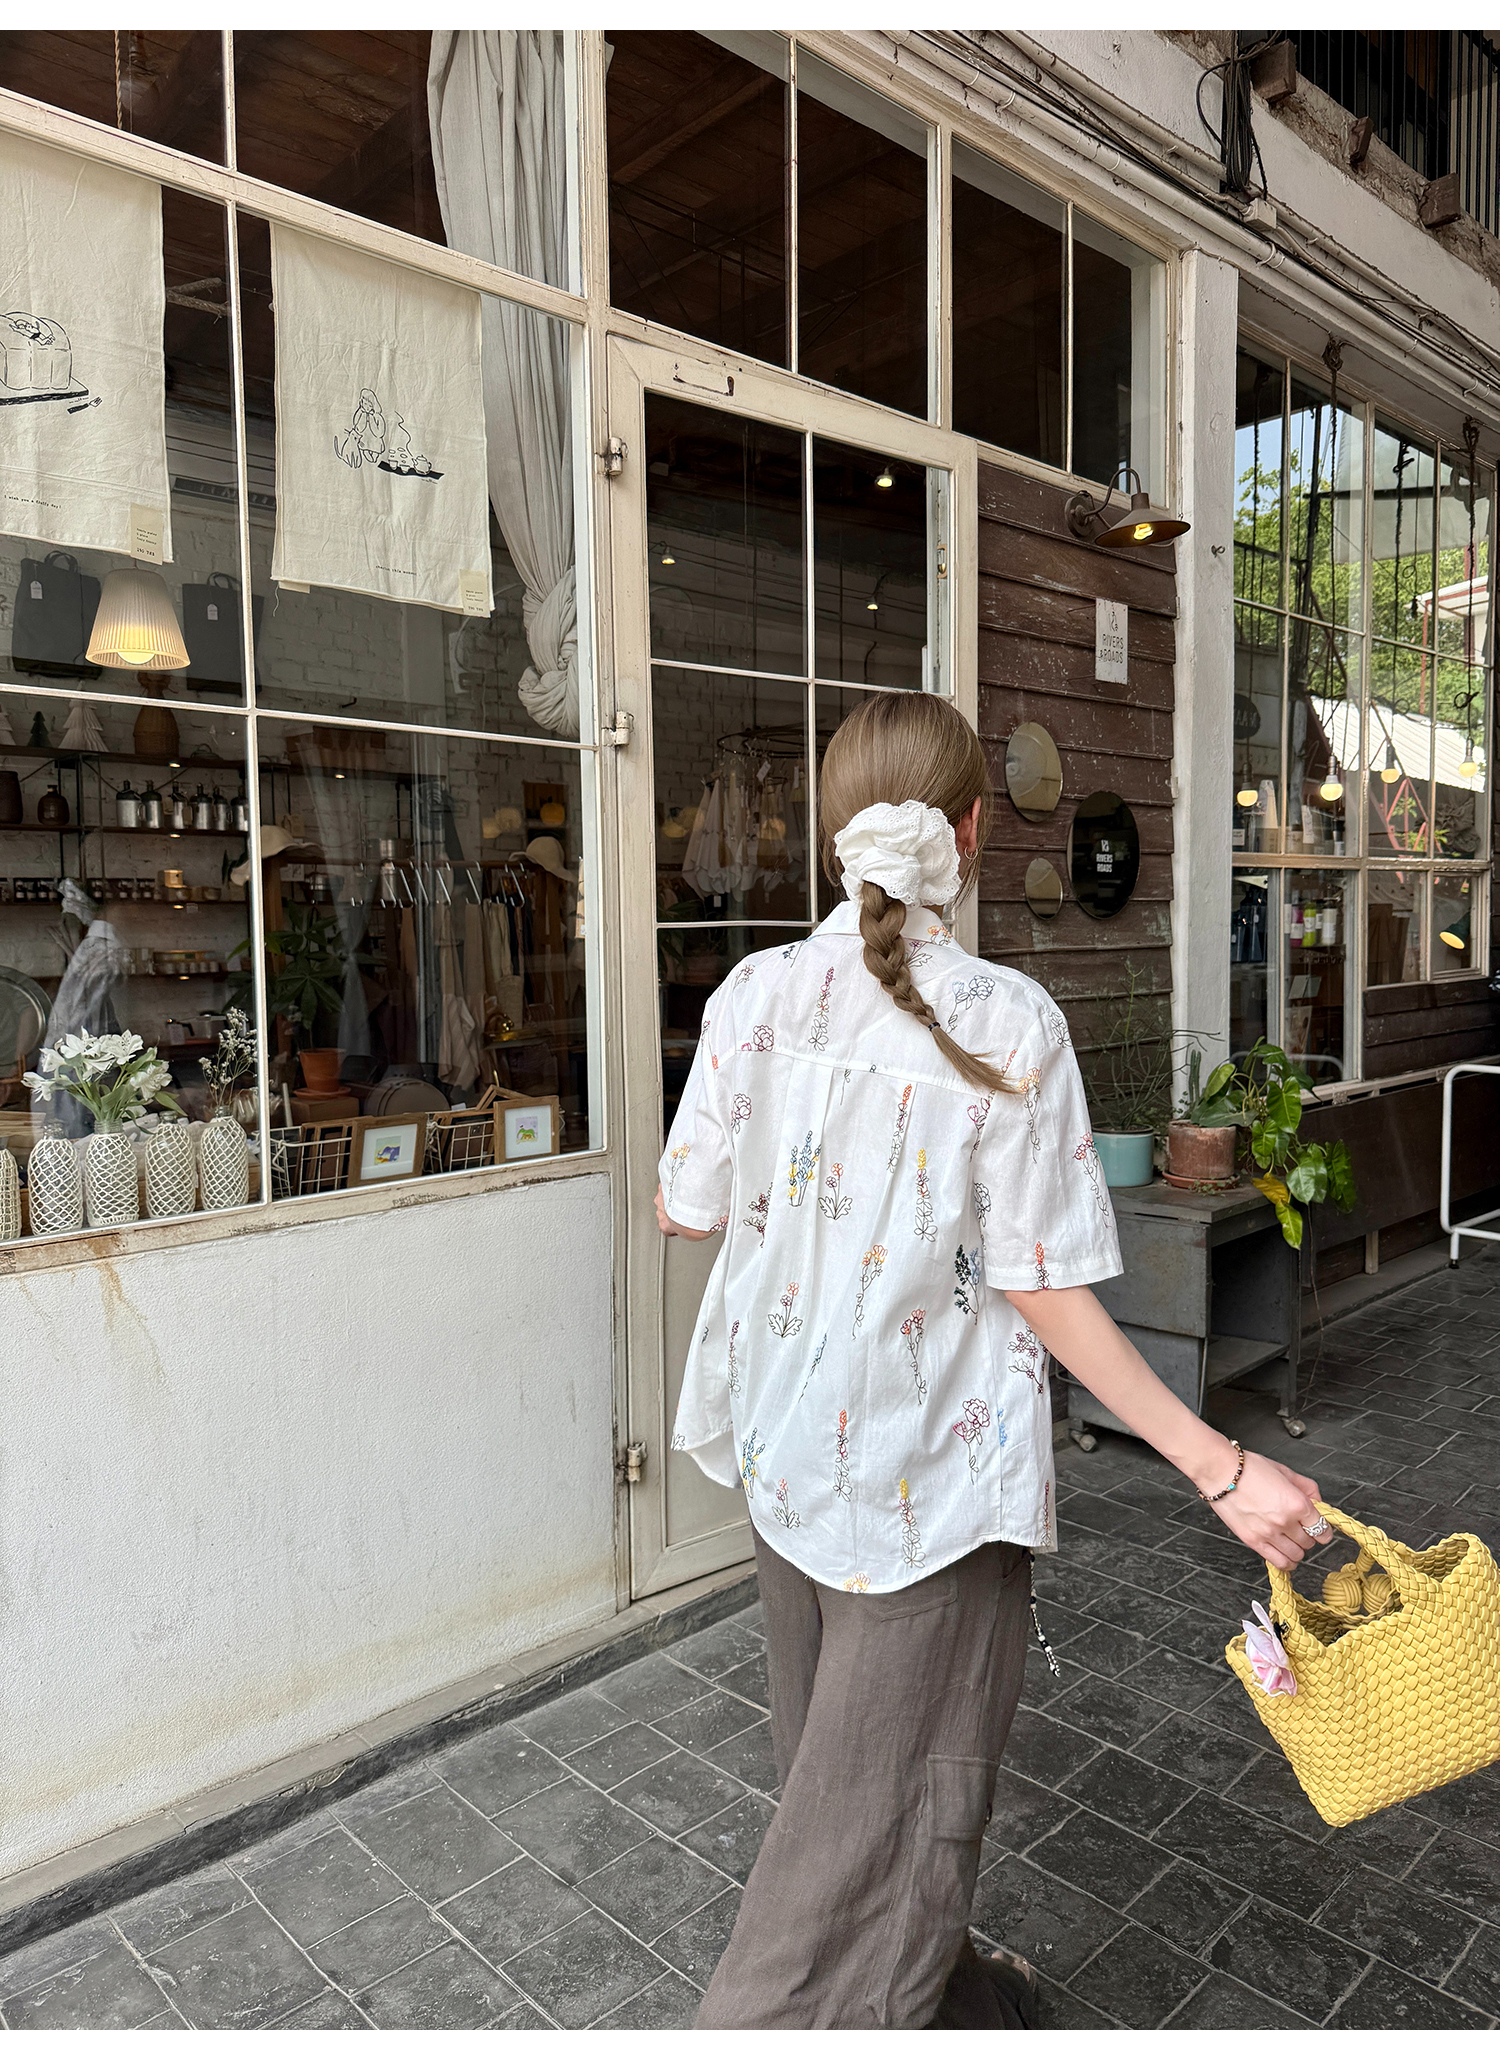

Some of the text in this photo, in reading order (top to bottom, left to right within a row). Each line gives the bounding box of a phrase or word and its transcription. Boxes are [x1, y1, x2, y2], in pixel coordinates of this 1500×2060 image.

[1102, 633, 1124, 650] RIVERS
[1096, 853, 1113, 863] RIVERS
[1097, 863, 1112, 873] ROADS
